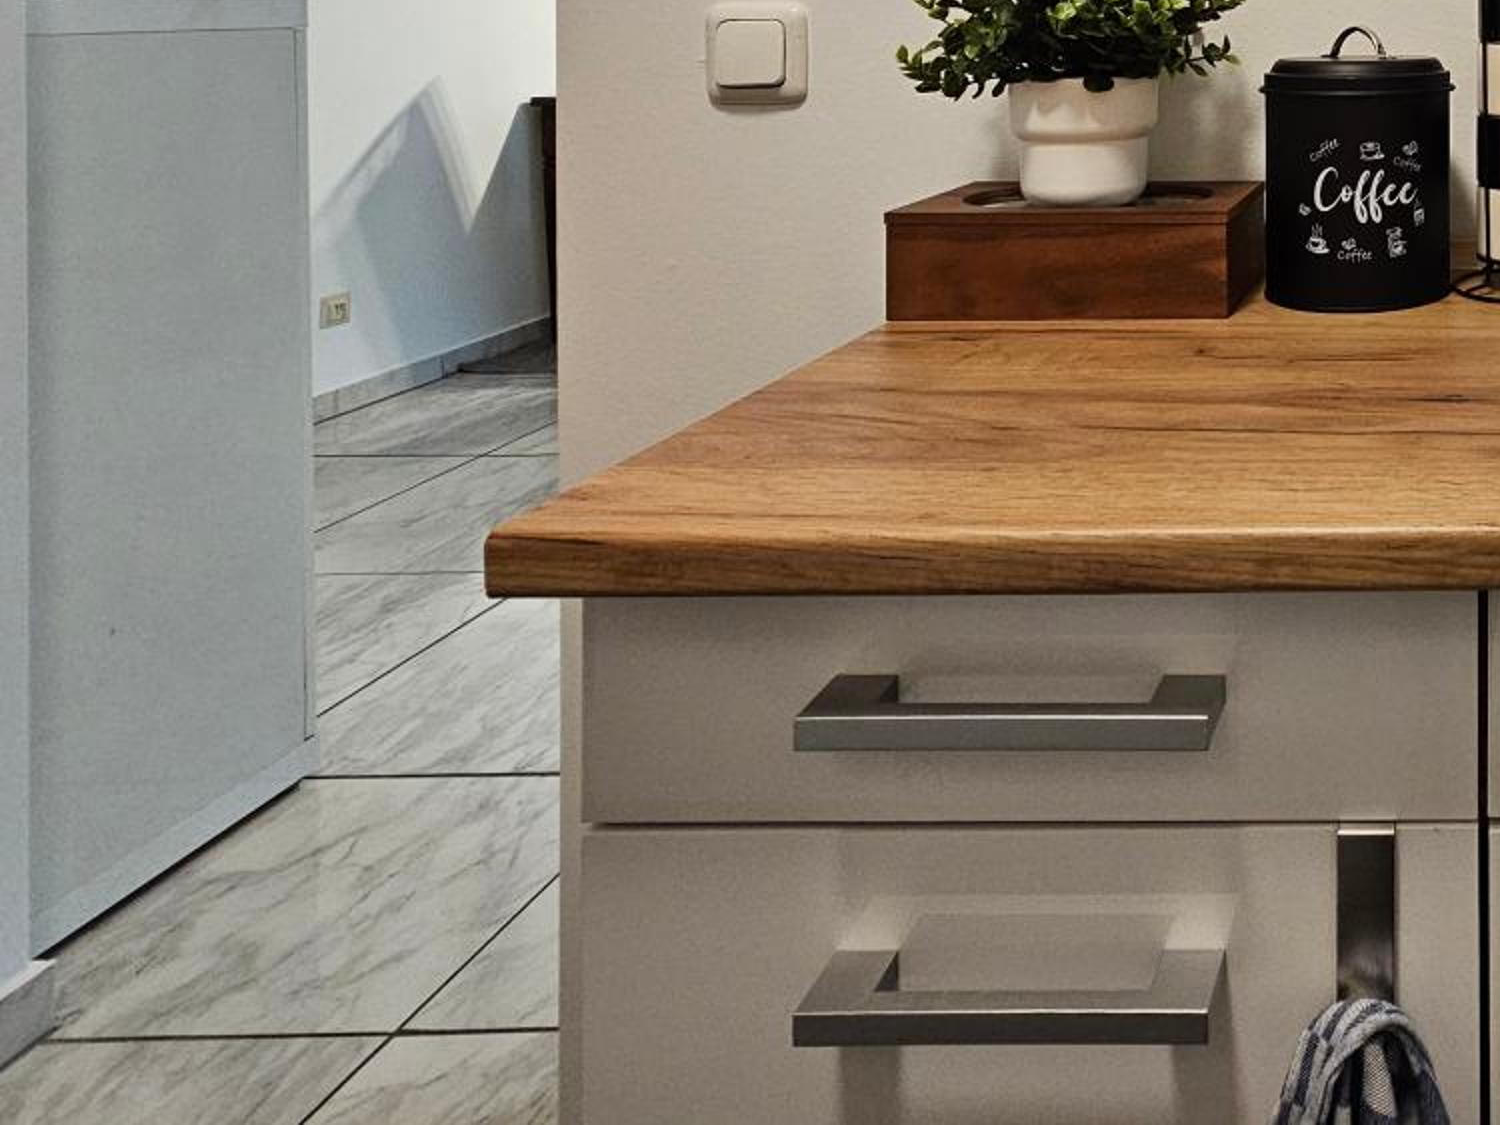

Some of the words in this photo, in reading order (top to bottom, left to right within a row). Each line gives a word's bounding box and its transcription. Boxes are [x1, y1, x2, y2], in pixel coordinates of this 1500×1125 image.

[1309, 138, 1341, 162] Coffee
[1313, 166, 1419, 224] Coffee
[1336, 248, 1373, 264] Coffee
